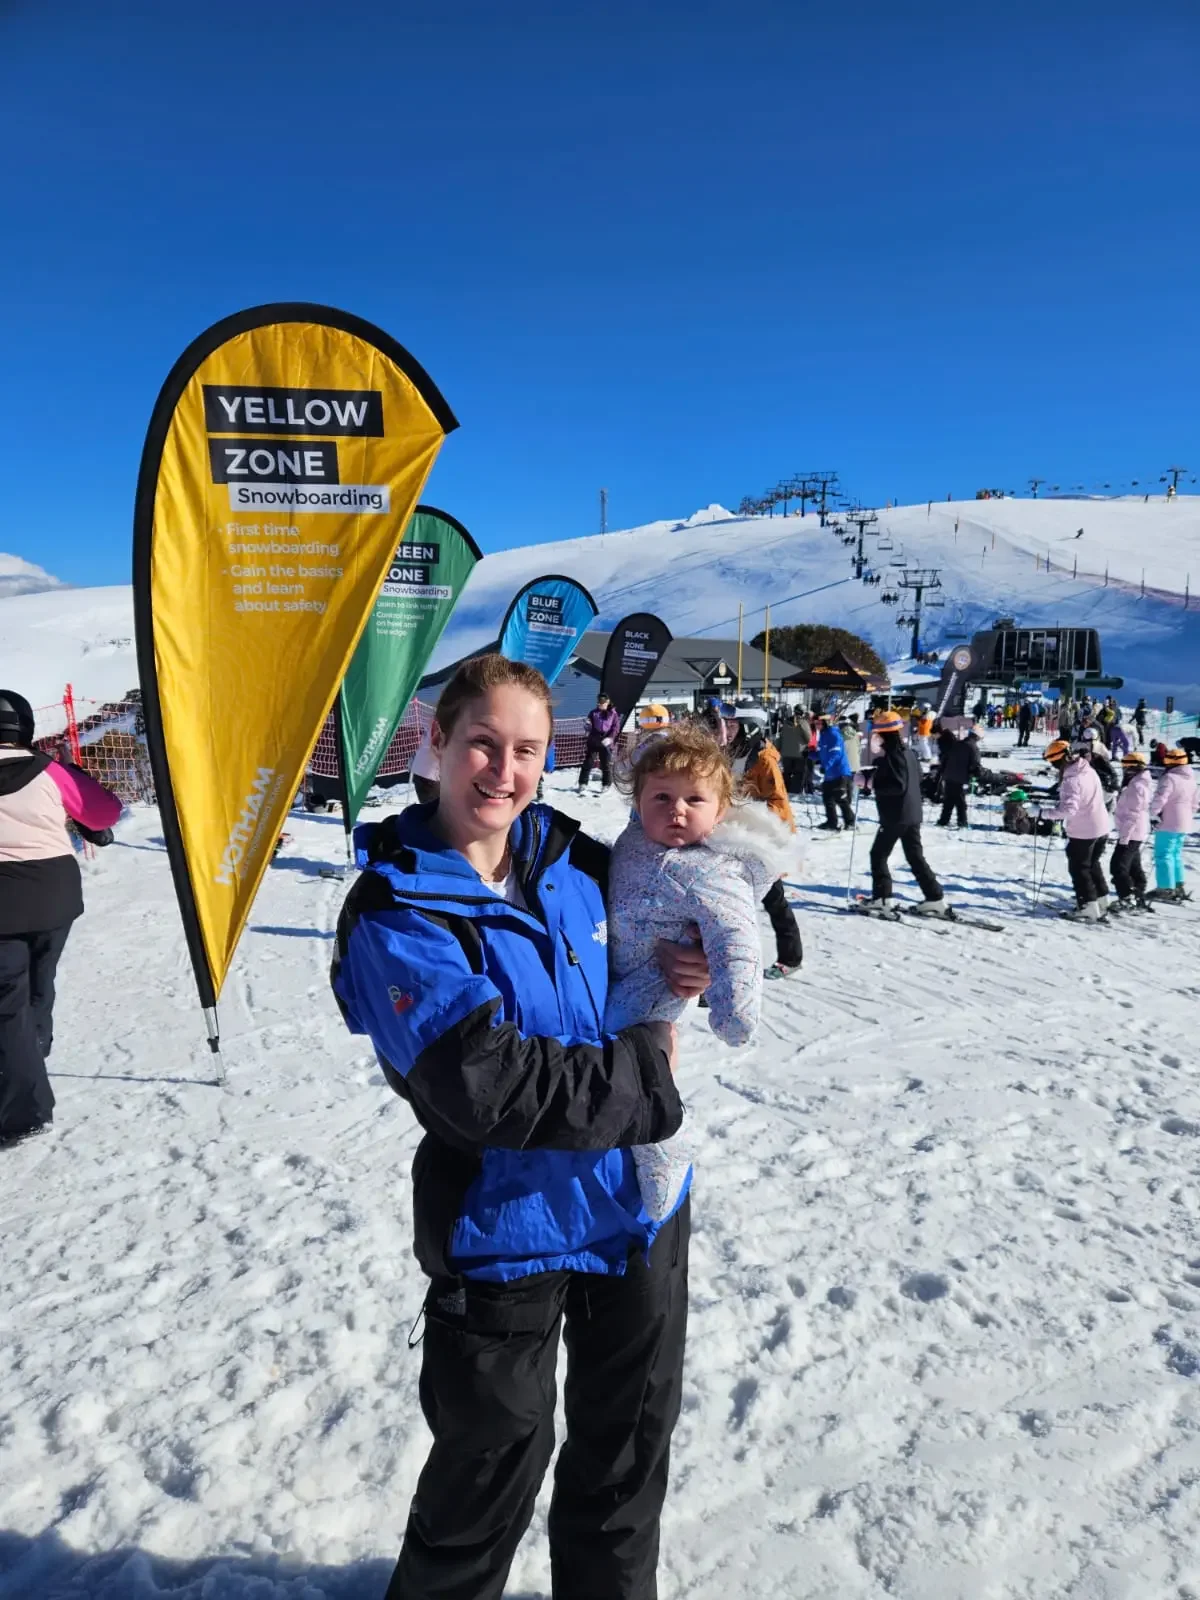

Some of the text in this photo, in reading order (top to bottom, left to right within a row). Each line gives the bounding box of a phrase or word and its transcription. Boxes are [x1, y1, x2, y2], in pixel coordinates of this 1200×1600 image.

[218, 396, 368, 427] YELLOW
[224, 448, 325, 477] ZONE
[238, 487, 383, 510] Snowboarding
[226, 522, 299, 537] First time
[229, 540, 339, 557] snowboarding
[395, 544, 433, 560] REEN
[230, 564, 344, 577] Gain the basics
[384, 567, 424, 582] ONE
[232, 582, 305, 594] and learn
[383, 585, 449, 598] Snowboarding
[235, 599, 327, 614] about safety
[532, 596, 559, 609] BLUE
[530, 612, 560, 624] ZONE
[625, 630, 649, 640] BLACK
[624, 641, 645, 650] ZONE
[355, 717, 388, 776] HOTHAM
[213, 766, 276, 887] HOTHAM
